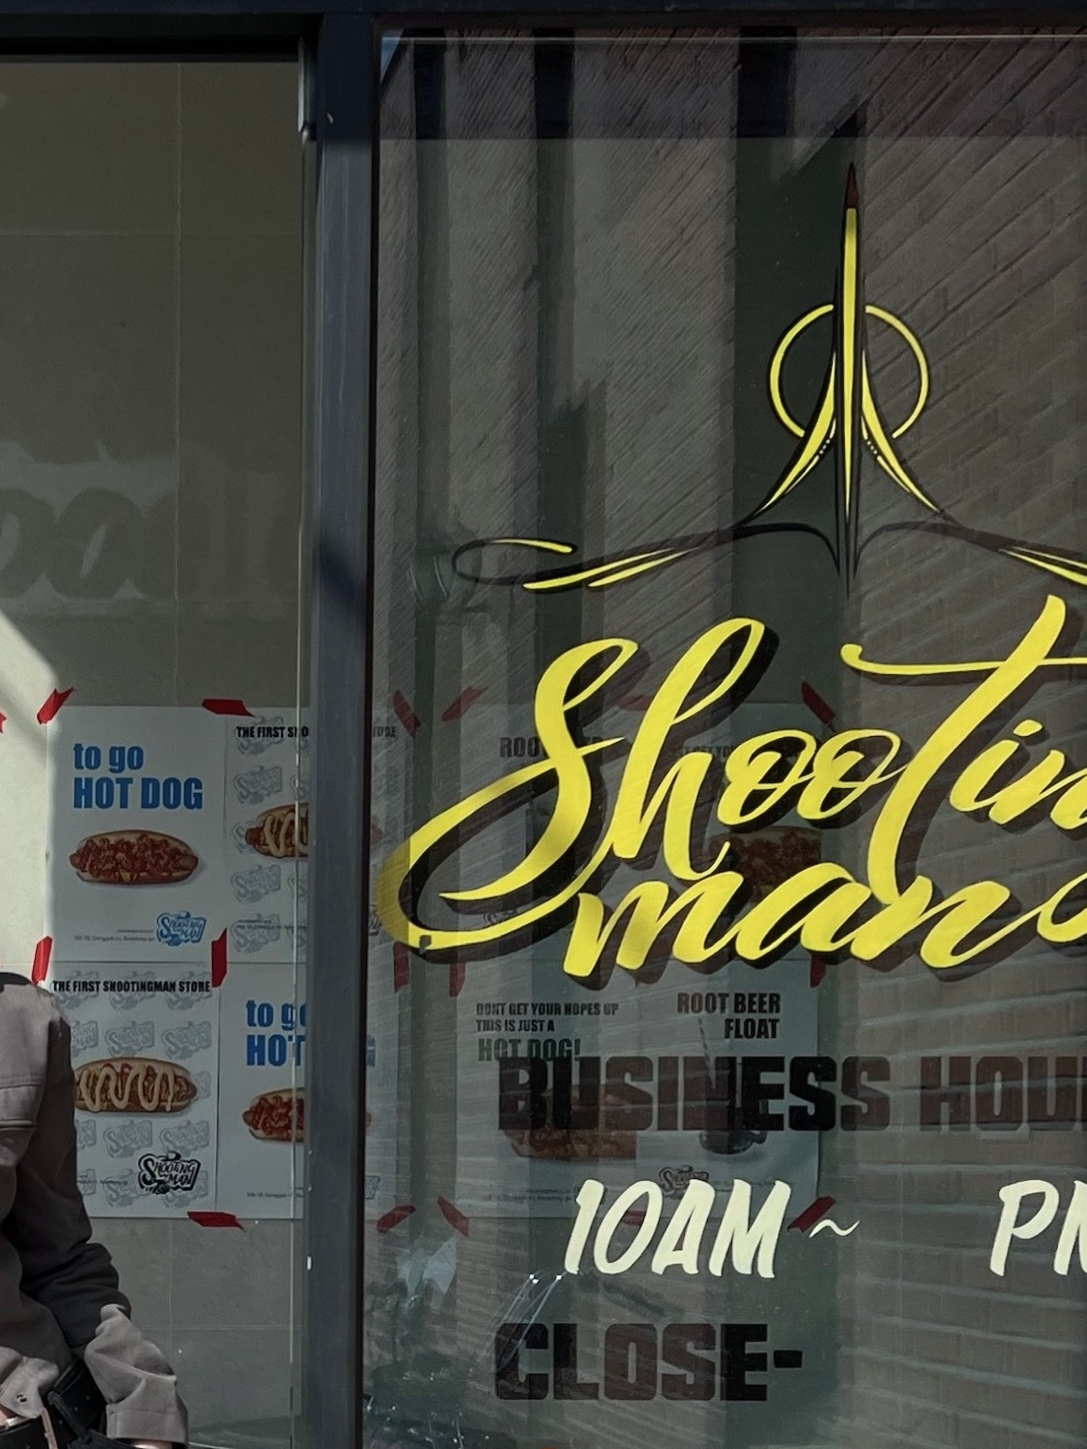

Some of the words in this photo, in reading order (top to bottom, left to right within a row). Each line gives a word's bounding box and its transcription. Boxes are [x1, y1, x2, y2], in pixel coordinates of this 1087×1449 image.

[236, 726, 254, 738] THE
[257, 726, 286, 738] FIRST
[73, 743, 102, 771] to
[109, 745, 144, 774] go
[500, 737, 543, 758] ROO
[73, 777, 134, 810] HOT
[140, 777, 203, 810] DOG
[52, 980, 71, 993] THE
[73, 980, 101, 993] FIRST
[103, 980, 177, 993] SHOOTINGMAN
[178, 980, 211, 993] STORE
[246, 1000, 274, 1028] to
[508, 1002, 530, 1016] GET
[531, 1002, 562, 1016] YOUR
[563, 1002, 601, 1016] HOPES
[603, 1003, 619, 1016] UP
[677, 992, 730, 1014] ROOT
[734, 992, 780, 1014] BEER
[476, 1019, 503, 1032] THIS
[504, 1019, 516, 1032] IS
[518, 1019, 546, 1032] JUST
[546, 1019, 556, 1032] A
[724, 1018, 780, 1039] FLOAT
[478, 1037, 522, 1062] HOT
[527, 1037, 582, 1062] DOG!
[498, 1056, 891, 1132] BUSINESS
[920, 1056, 1087, 1132] HOU
[564, 1179, 791, 1278] 10AM
